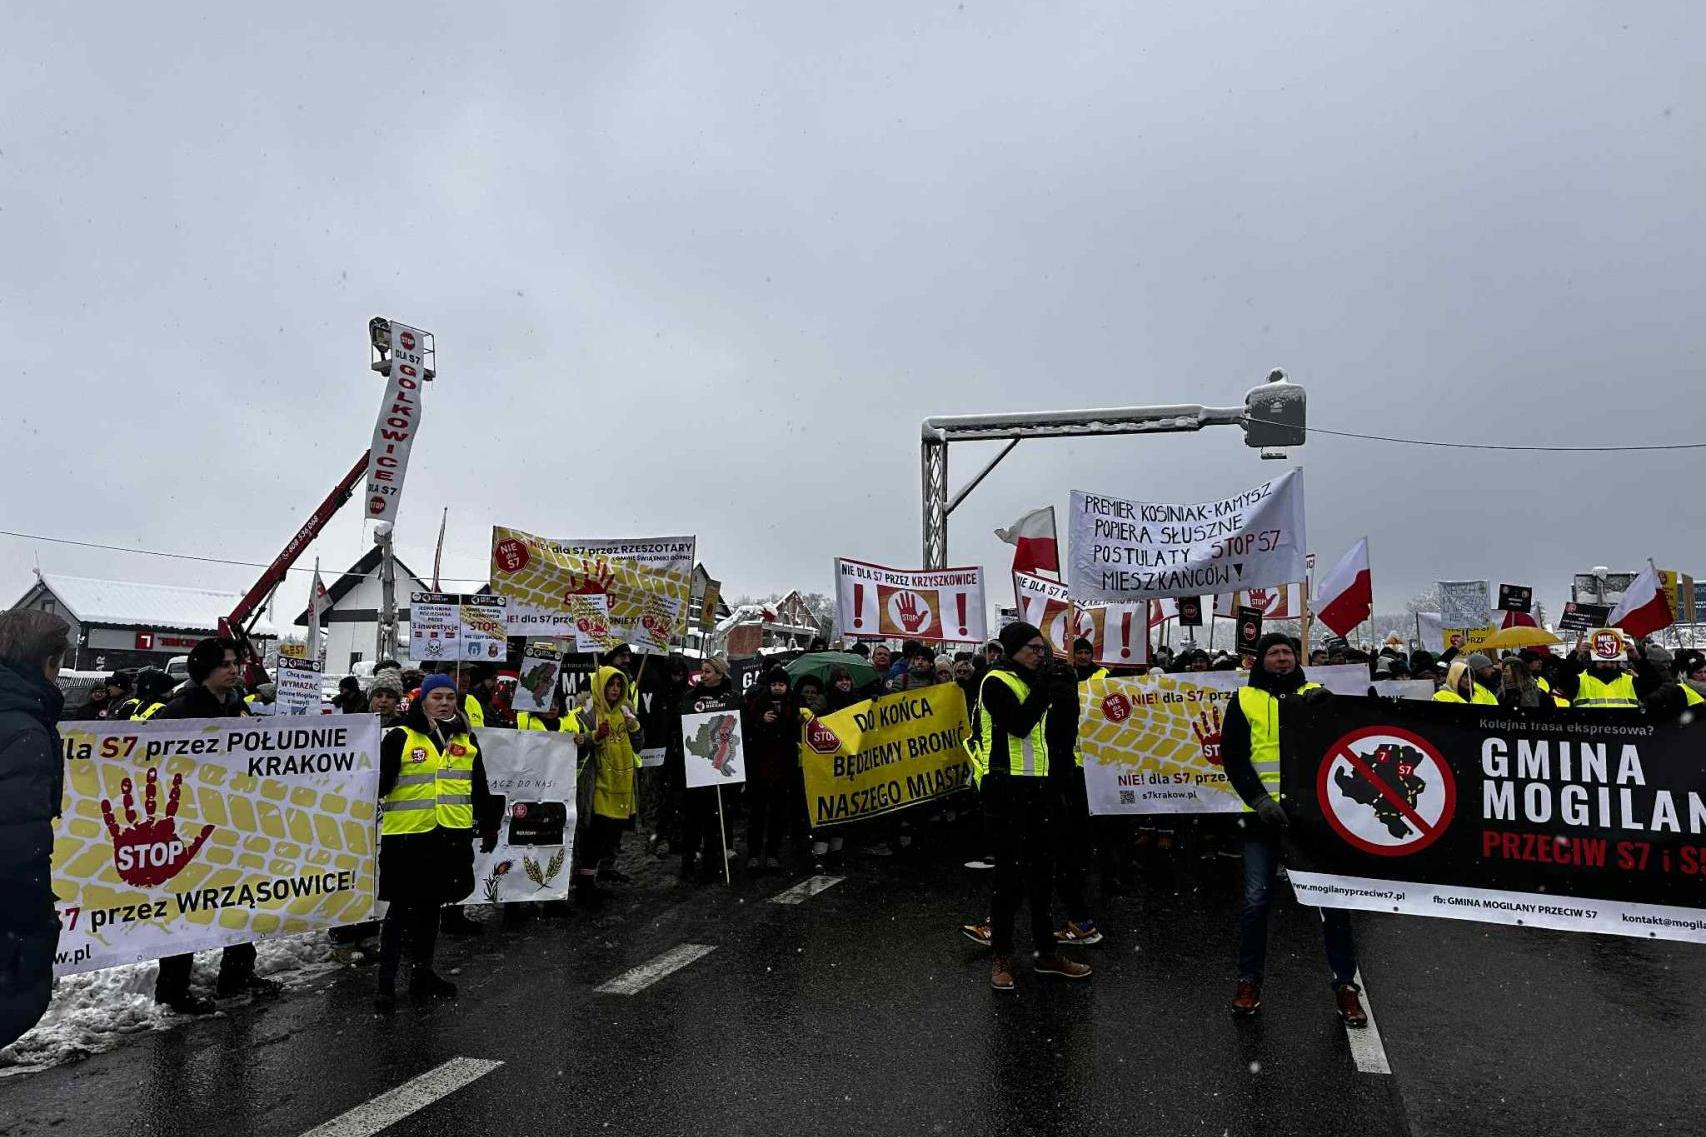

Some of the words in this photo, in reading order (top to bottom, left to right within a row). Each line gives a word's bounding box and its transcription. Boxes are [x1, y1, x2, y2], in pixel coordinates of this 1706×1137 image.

[409, 354, 421, 365] S7
[375, 364, 417, 482] GOLKOWICE
[381, 486, 398, 495] S7
[1084, 495, 1136, 520] PREMIER
[1141, 482, 1273, 523] KOSINIAK-KAMYSZ
[1094, 519, 1153, 543] POPIERA
[1160, 514, 1243, 545] SŁUSZNE
[500, 543, 518, 555] NIE
[552, 544, 571, 555] dla
[573, 546, 586, 555] S7
[588, 546, 619, 557] przez
[621, 543, 693, 554] RZESZOTARY
[1093, 545, 1190, 568] POSTULATY
[1211, 533, 1255, 560] STOP
[1258, 529, 1281, 552] S7
[507, 557, 520, 569] S7
[841, 563, 855, 576] NIE
[856, 567, 872, 580] DLA
[874, 571, 883, 582] S7
[885, 574, 910, 587] PRZEZ
[912, 573, 977, 587] KRZYSZKOWICE
[1102, 565, 1229, 591] MIESZKAŃCÓW
[1029, 580, 1046, 593] DLA
[1048, 587, 1059, 599] S7
[418, 622, 459, 631] inwestycje
[470, 621, 498, 632] STOP
[521, 615, 537, 624] dla
[539, 615, 552, 624] S7
[1604, 642, 1617, 654] S7
[1106, 696, 1121, 708] NIE
[1132, 693, 1158, 705] NIE!
[1162, 692, 1184, 704] dla
[1187, 691, 1204, 702] S7
[853, 711, 876, 733] DO
[880, 696, 934, 728] KOŃCA
[1113, 708, 1125, 719] S7
[1479, 719, 1527, 731] Kolejna
[1531, 721, 1564, 732] trasa
[101, 736, 139, 759] S7
[145, 738, 220, 761] przez
[227, 728, 348, 752] POŁUDNIE
[1204, 744, 1221, 757] ST
[833, 740, 903, 784] BĘDZIEMY
[907, 721, 966, 758] BRONIĆ
[1379, 752, 1387, 760] 7
[1481, 737, 1646, 786] GMINA
[1398, 765, 1412, 775] S7
[517, 780, 531, 788] DO
[1118, 773, 1145, 786] NIE!
[1149, 773, 1170, 785] dla
[1173, 773, 1190, 784] S7
[817, 780, 901, 821] NASZEGO
[906, 761, 971, 800] MIASTA
[1142, 789, 1198, 800] s7krakow.pl
[117, 843, 184, 871] STOP
[1482, 831, 1607, 867] PRZECIW
[1616, 842, 1650, 870] S7
[1663, 850, 1671, 872] i
[56, 907, 81, 932] 7
[91, 900, 168, 933] przez
[176, 871, 357, 915] WRZĄSOWICE!
[1433, 895, 1446, 904] fb:
[1448, 897, 1481, 908] GMINA
[1483, 900, 1536, 913] MOGILANY
[1538, 905, 1583, 918] PRZECIW
[1585, 910, 1598, 919] S7
